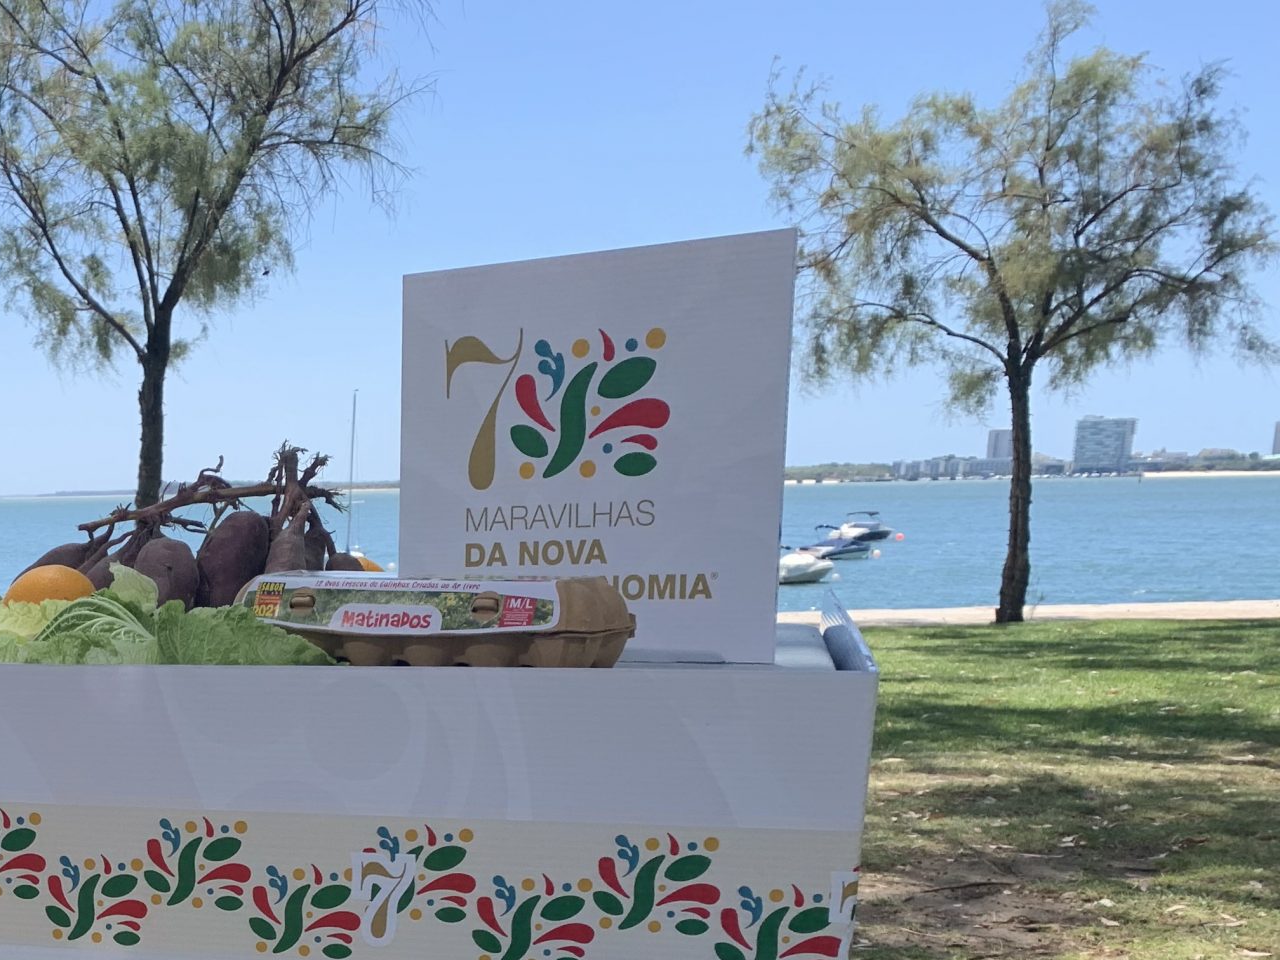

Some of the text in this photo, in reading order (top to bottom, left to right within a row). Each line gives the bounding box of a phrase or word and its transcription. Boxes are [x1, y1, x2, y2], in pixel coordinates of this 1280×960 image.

[444, 327, 524, 490] 7
[464, 499, 656, 532] MARAVILHAS
[464, 539, 608, 568] DA NOVA
[261, 582, 285, 592] SABOR
[252, 603, 281, 618] 2021
